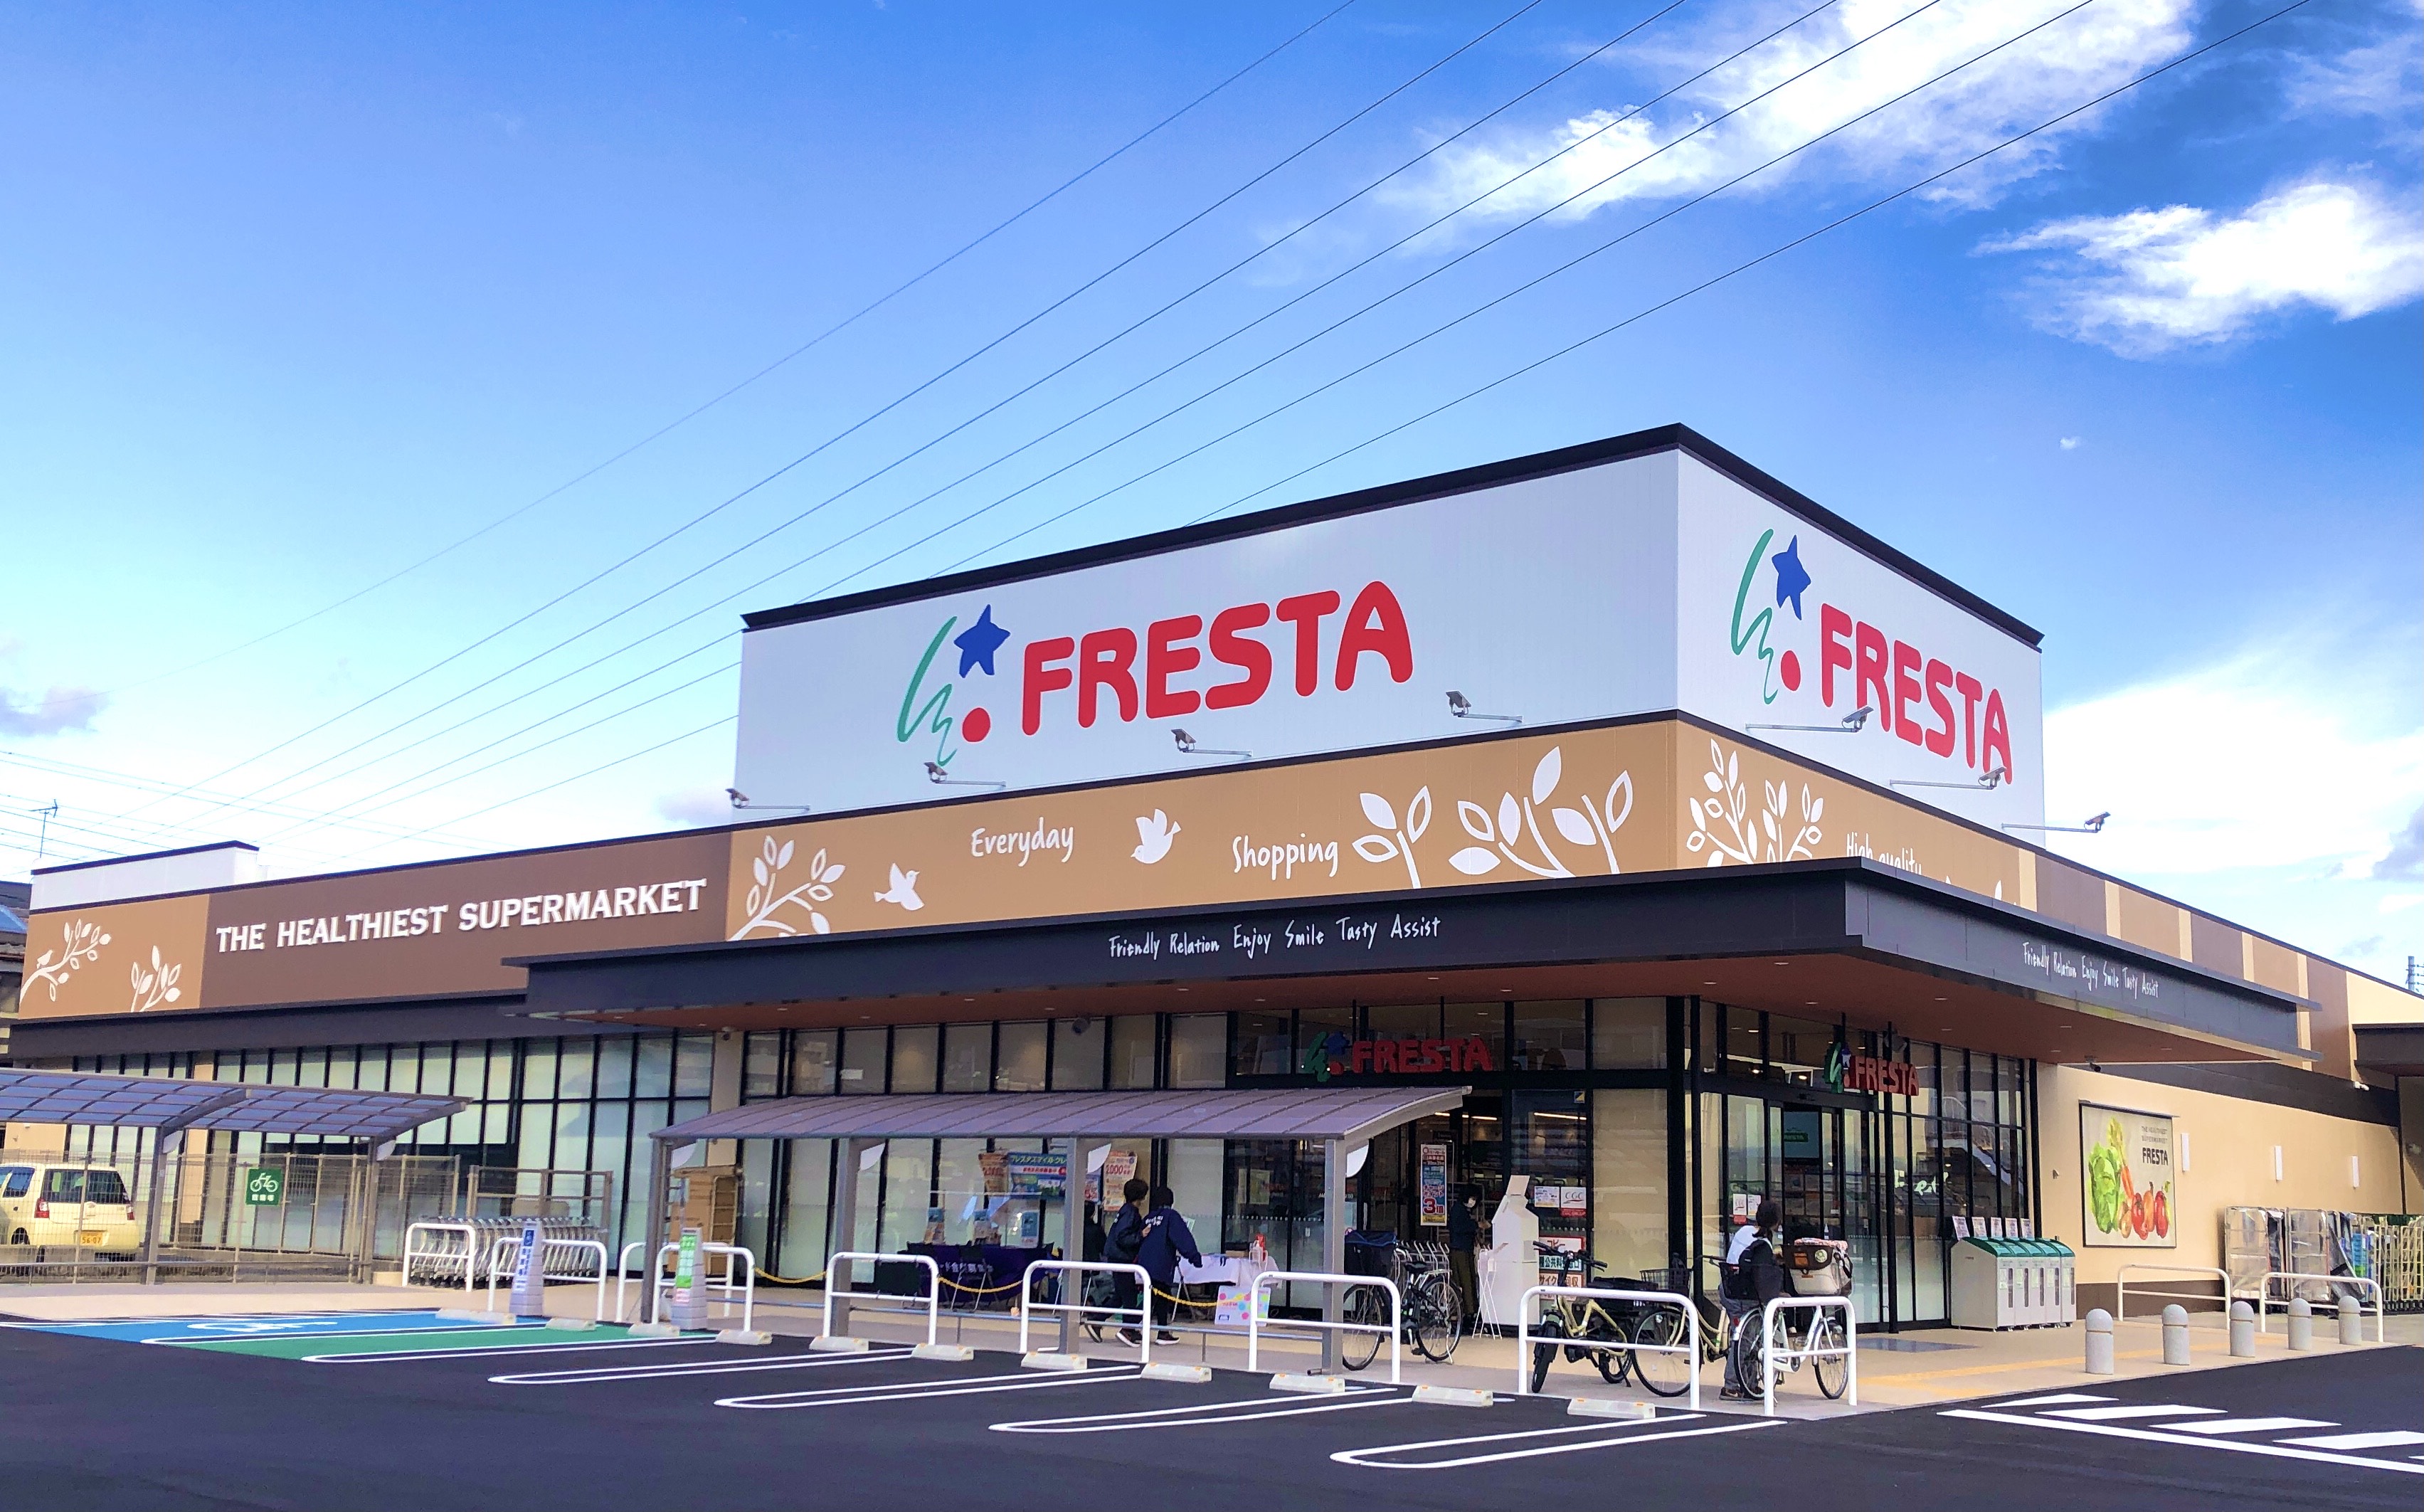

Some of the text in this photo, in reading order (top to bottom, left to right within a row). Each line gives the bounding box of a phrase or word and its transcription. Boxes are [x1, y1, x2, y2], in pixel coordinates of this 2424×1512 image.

[1022, 581, 1414, 736] FRESTA
[1821, 603, 2013, 785] FRESTA
[971, 817, 1074, 867] Everyday
[1232, 832, 1339, 881] Shopping
[216, 877, 707, 953] THE HEALTHIEST SUPERMARKET
[1108, 913, 1441, 961] Friendly Relation Enjoy Smile Tasty Assist
[2022, 941, 2159, 1000] Friendly Relation Enjoy Smile Tasty Assist
[1353, 1037, 1493, 1074] FRESTA
[1853, 1054, 1920, 1096] FRESTA
[2142, 1147, 2169, 1166] FRESTA
[1565, 1191, 1583, 1200] CGC
